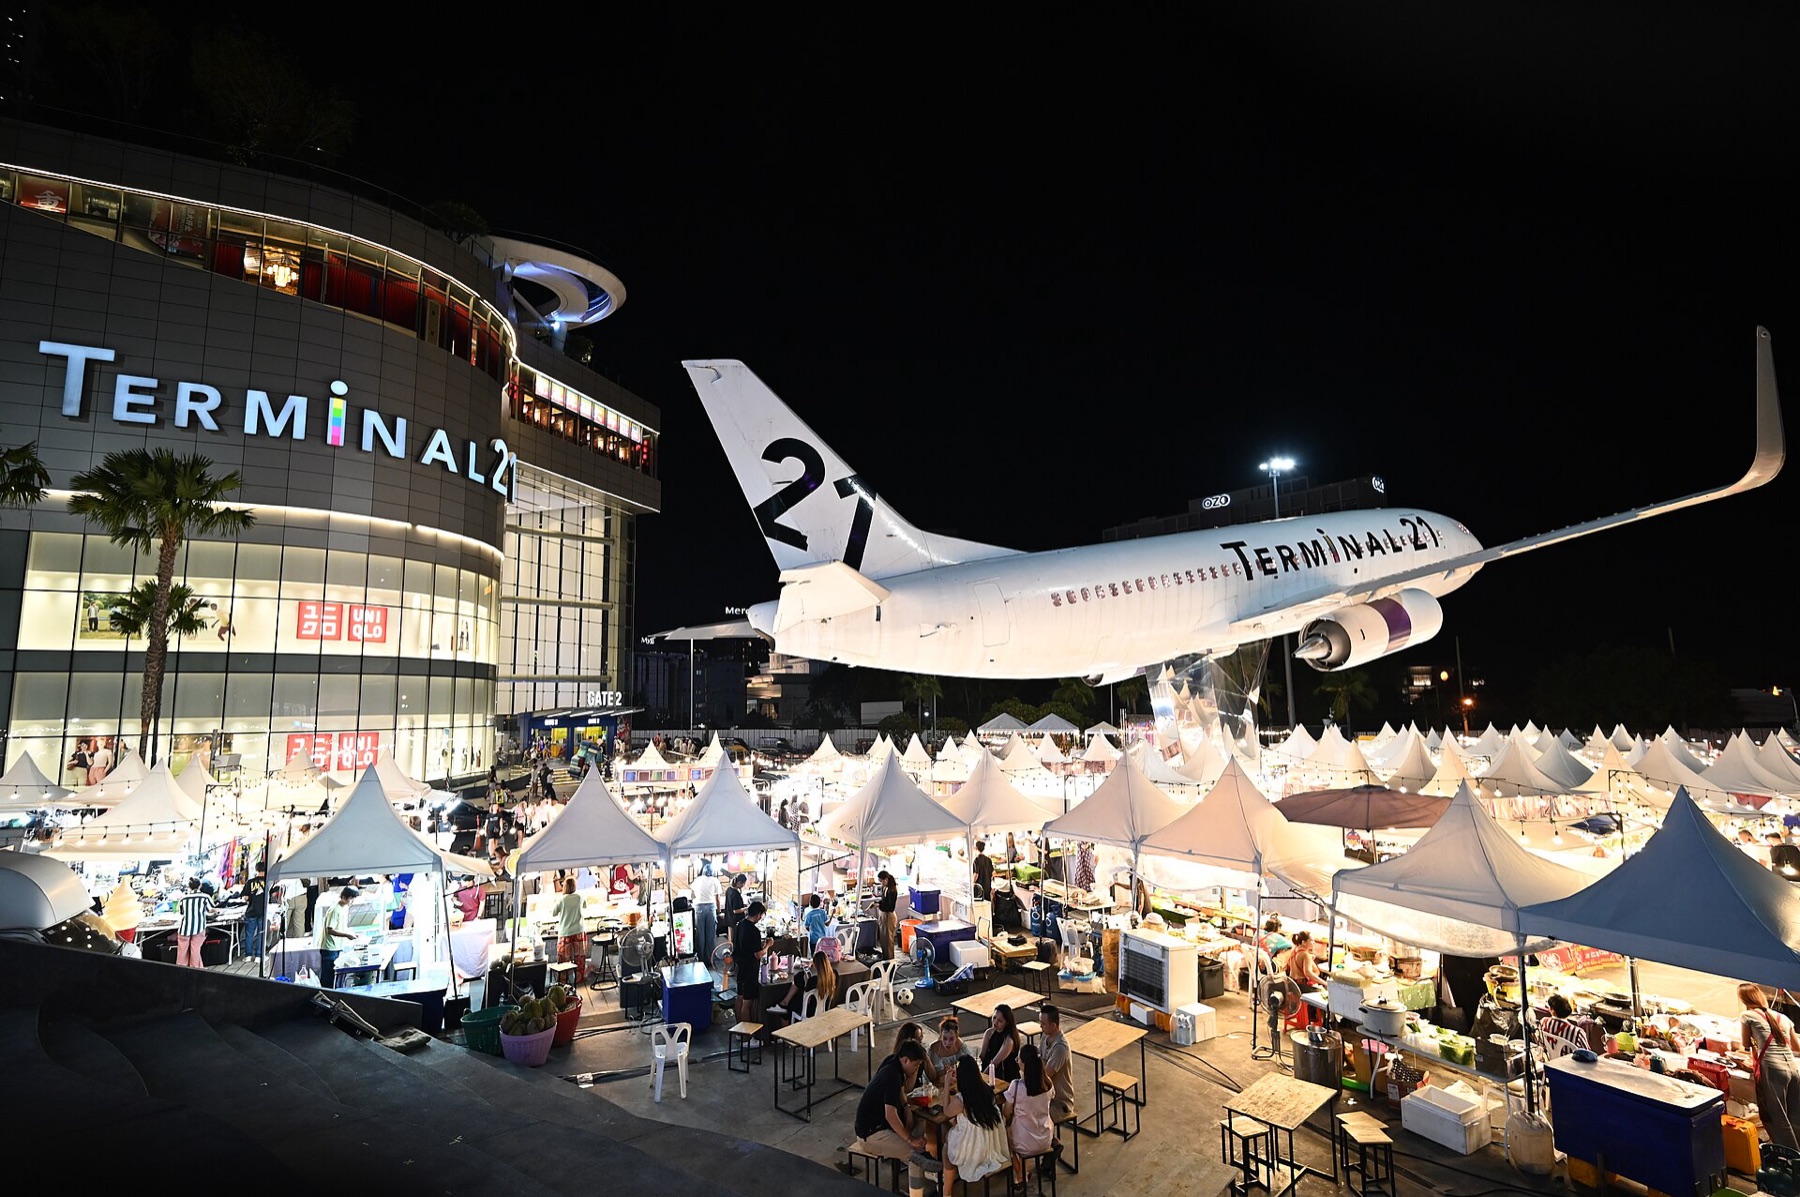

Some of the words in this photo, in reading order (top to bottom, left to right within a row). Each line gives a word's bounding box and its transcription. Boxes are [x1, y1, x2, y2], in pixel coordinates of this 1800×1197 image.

[753, 437, 877, 573] 21
[587, 690, 614, 707] GATE
[615, 691, 623, 706] 2
